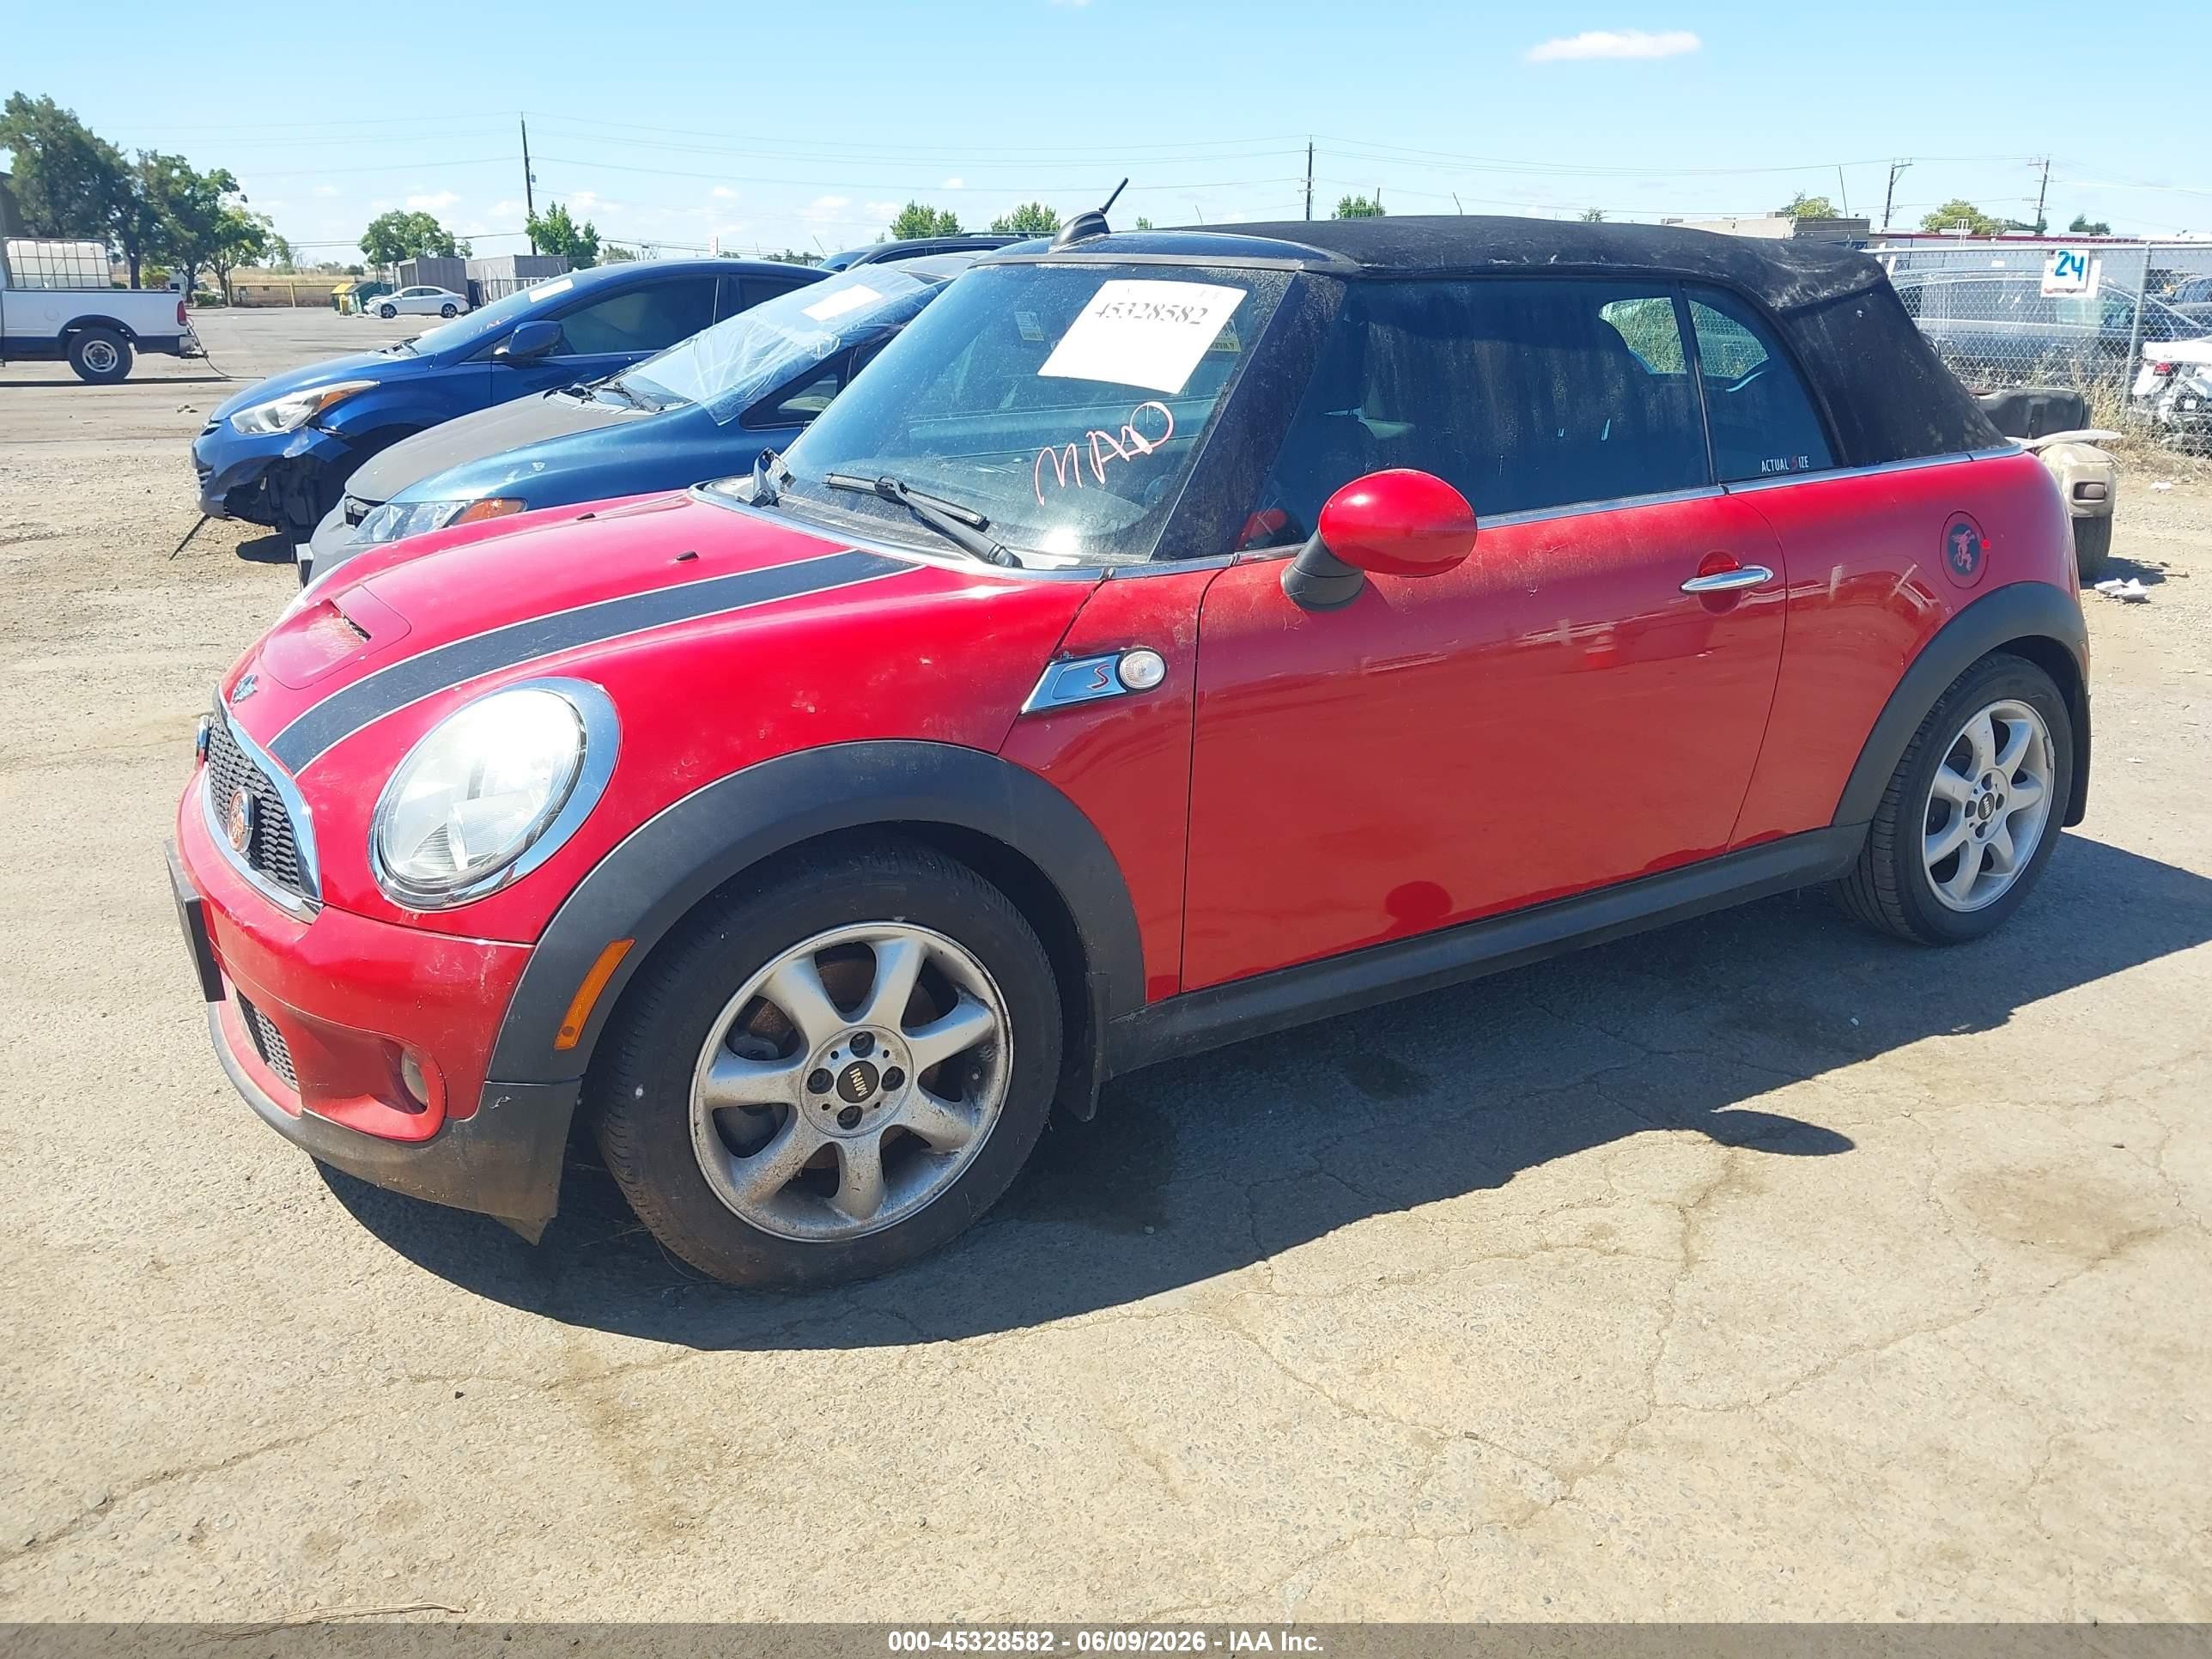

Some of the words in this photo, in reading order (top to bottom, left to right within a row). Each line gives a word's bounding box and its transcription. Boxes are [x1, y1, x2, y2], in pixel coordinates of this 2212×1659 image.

[2054, 251, 2085, 282] 24
[1094, 301, 1209, 325] 45328582
[1761, 458, 1790, 473] ACTUAL
[1086, 664, 1112, 690] S
[848, 1067, 869, 1097] MINI
